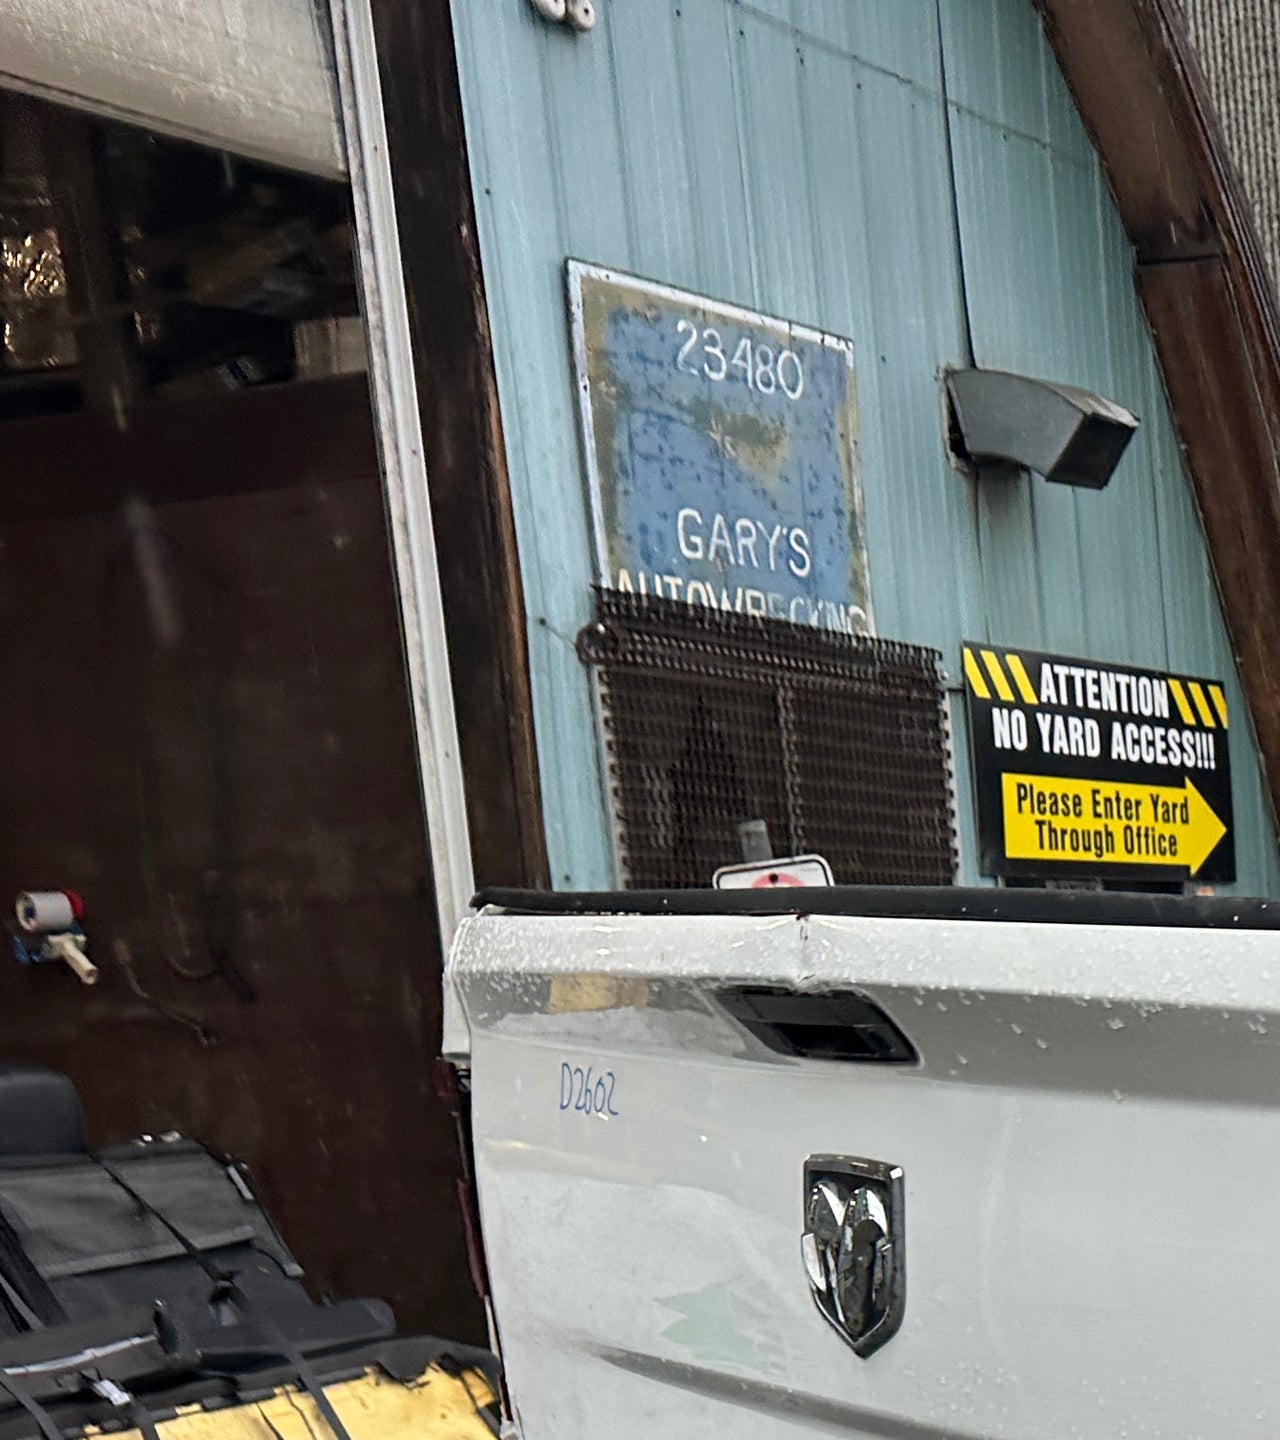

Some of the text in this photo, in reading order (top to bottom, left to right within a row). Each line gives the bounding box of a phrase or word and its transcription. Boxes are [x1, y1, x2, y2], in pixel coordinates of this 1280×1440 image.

[676, 319, 804, 400] 23480
[677, 507, 811, 578] GARY'S
[1040, 662, 1169, 718] ATTENTION
[992, 707, 1216, 770] NO YARD ACCESS!!!
[1016, 782, 1189, 825] Please Enter Yard
[1035, 819, 1178, 858] Through Office
